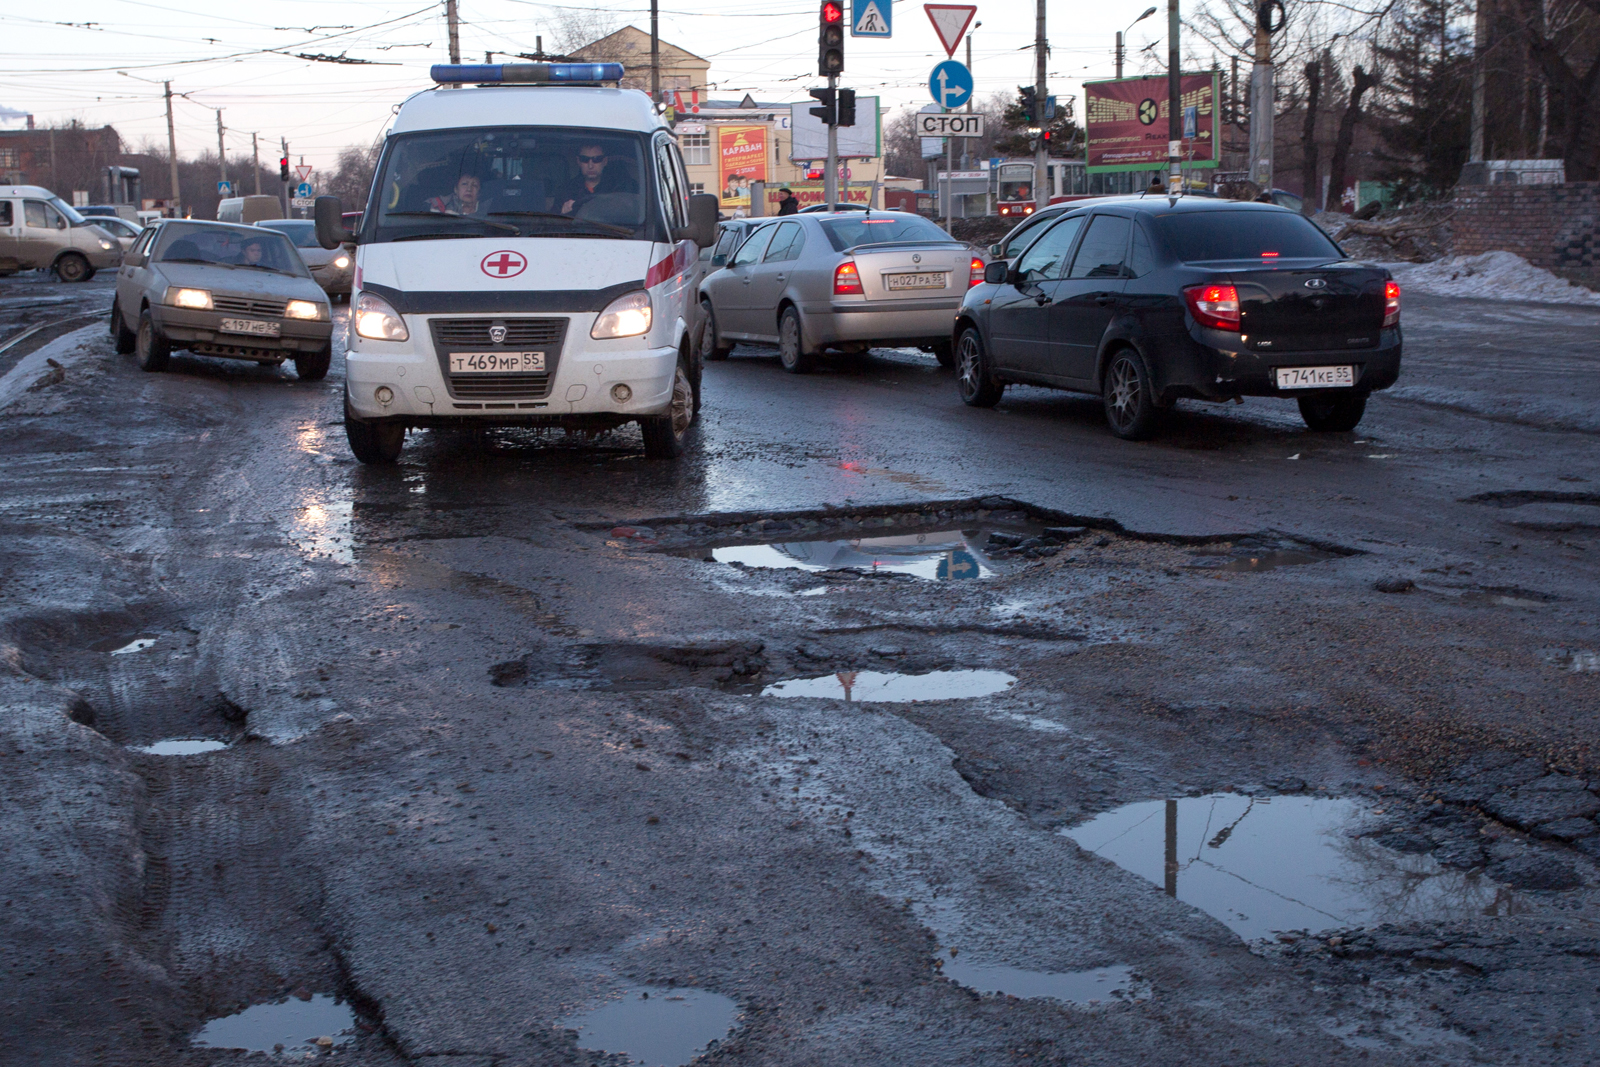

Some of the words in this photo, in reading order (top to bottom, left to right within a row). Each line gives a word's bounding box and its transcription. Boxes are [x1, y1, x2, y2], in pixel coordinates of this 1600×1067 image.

[923, 117, 978, 132] СТОП
[722, 143, 763, 156] КАРАВАН
[724, 152, 764, 163] ГИПЕРМАРКЕТ
[932, 274, 941, 282] 55
[523, 354, 539, 364] 55
[1336, 367, 1348, 378] 55
